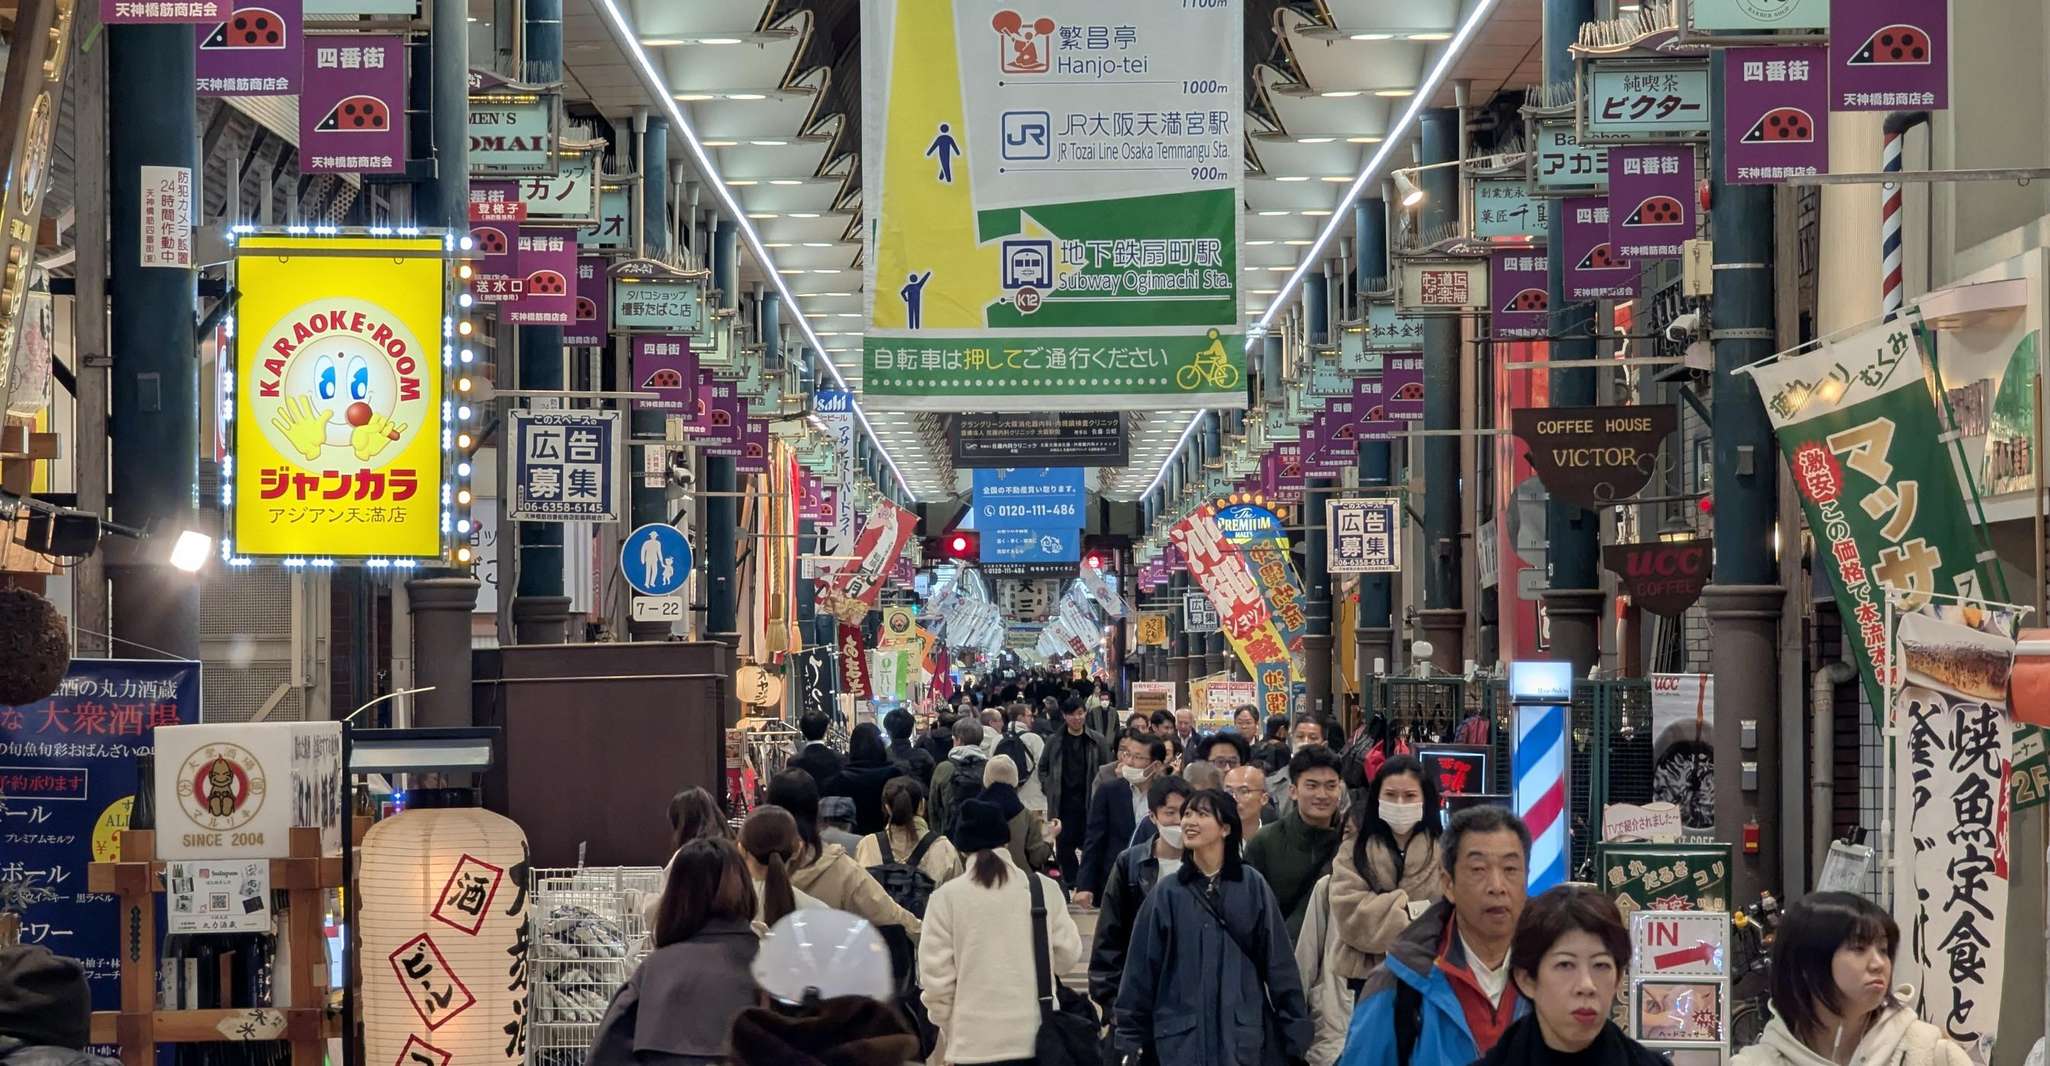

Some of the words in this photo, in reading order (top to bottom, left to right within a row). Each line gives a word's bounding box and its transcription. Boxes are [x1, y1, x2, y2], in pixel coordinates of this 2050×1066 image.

[115, 2, 218, 17] 天神橋筋商店会
[1058, 25, 1137, 50] 繁昌亭
[317, 47, 385, 69] 四番街
[1057, 55, 1149, 78] Hanjo-tei
[1743, 60, 1810, 82] 四番街
[196, 77, 289, 92] 天神橋筋商店会
[1181, 80, 1229, 95] 1000m
[1623, 74, 1679, 93] 純喫茶
[1602, 94, 1700, 121] ビクター
[1843, 91, 1935, 107] 天神橋筋商店会
[1056, 110, 1231, 137] JR大阪天満宮駅
[1006, 124, 1046, 147] JR
[312, 156, 393, 168] 天神橋筋商店会
[1057, 144, 1069, 162] JR
[1071, 141, 1097, 160] Tozai
[1100, 142, 1119, 160] Line
[1121, 142, 1154, 160] Osaka
[1157, 141, 1211, 163] Temmangu
[1212, 141, 1231, 159] Sta.
[1190, 168, 1229, 182] 900m
[1624, 156, 1679, 175] 四番街
[1737, 166, 1818, 179] 天神橋筋商店会
[160, 180, 175, 264] 24時間作動中
[177, 171, 189, 264] 防犯カメラ設置
[518, 236, 565, 252] 四番街
[1060, 238, 1224, 267] 地下鉄扇町駅
[1504, 256, 1549, 272] 四番街
[476, 280, 523, 293] 送水口
[1058, 270, 1119, 294] Subway
[1125, 269, 1200, 293] Ogimachi
[1202, 268, 1233, 290] Sta.
[626, 290, 687, 300] タバコショップ
[1017, 293, 1039, 308] K12
[644, 343, 681, 356] 四番街
[874, 346, 1169, 372] 自転車は押してご通行ください
[534, 414, 597, 426] このスペースの
[1537, 419, 1594, 434] COFFEE
[1605, 418, 1652, 432] HOUSE
[530, 430, 598, 463] 広告
[1552, 447, 1638, 468] VICTOR
[529, 467, 599, 499] 募集
[1800, 448, 1836, 498] 激安
[524, 502, 603, 513] 06-6358-6145
[998, 504, 1076, 517] 0120-111-486
[1341, 512, 1385, 532] 広告
[1340, 537, 1386, 557] 募集
[1637, 579, 1694, 596] COFFEE
[36, 701, 180, 736] 大衆酒場
[2011, 766, 2049, 804] 2F
[5, 833, 76, 844] プレミアムモルツ
[183, 833, 223, 848] SINCE
[231, 832, 265, 847] 2004
[1937, 702, 2002, 1042] 焼魚定食と
[447, 872, 489, 915] 酒
[1647, 921, 1679, 947] IN
[402, 943, 453, 1014] ビール
